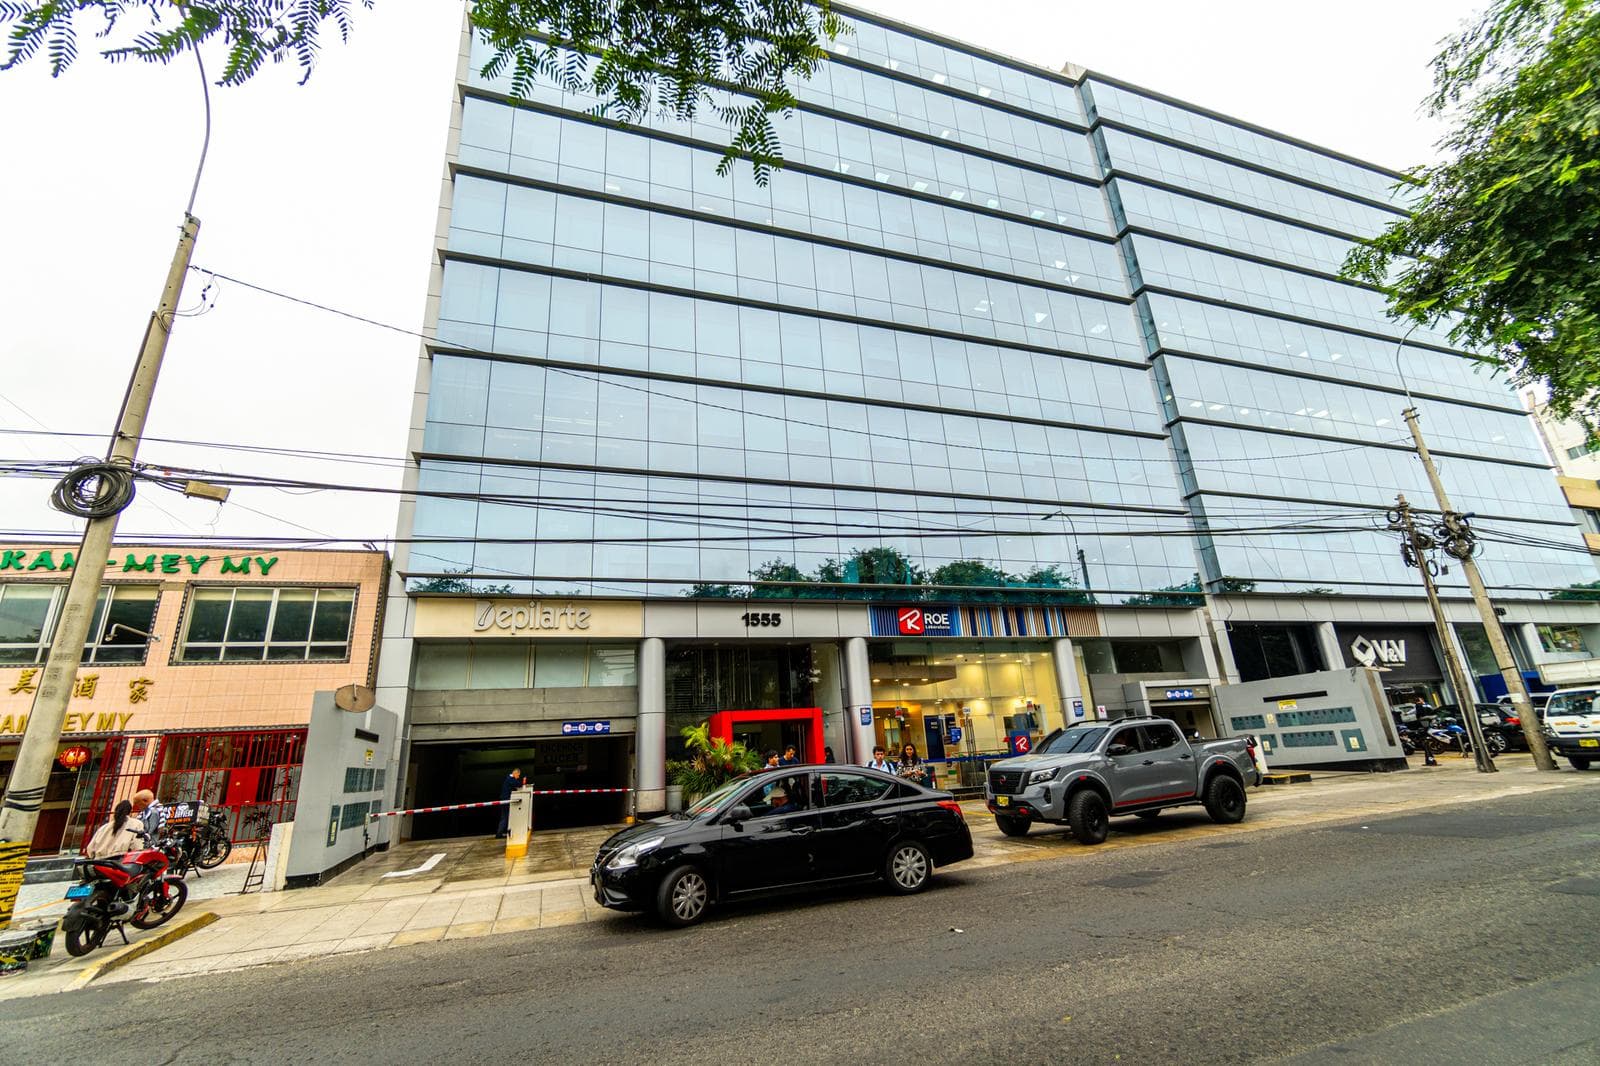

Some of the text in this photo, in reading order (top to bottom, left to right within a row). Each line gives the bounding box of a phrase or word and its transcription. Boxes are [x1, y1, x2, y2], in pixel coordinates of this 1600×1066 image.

[220, 556, 278, 575] MY
[474, 600, 592, 634] Depilarte
[741, 612, 781, 627] 1555
[923, 613, 950, 625] ROE
[1370, 639, 1406, 662] V&V
[96, 712, 134, 731] MY
